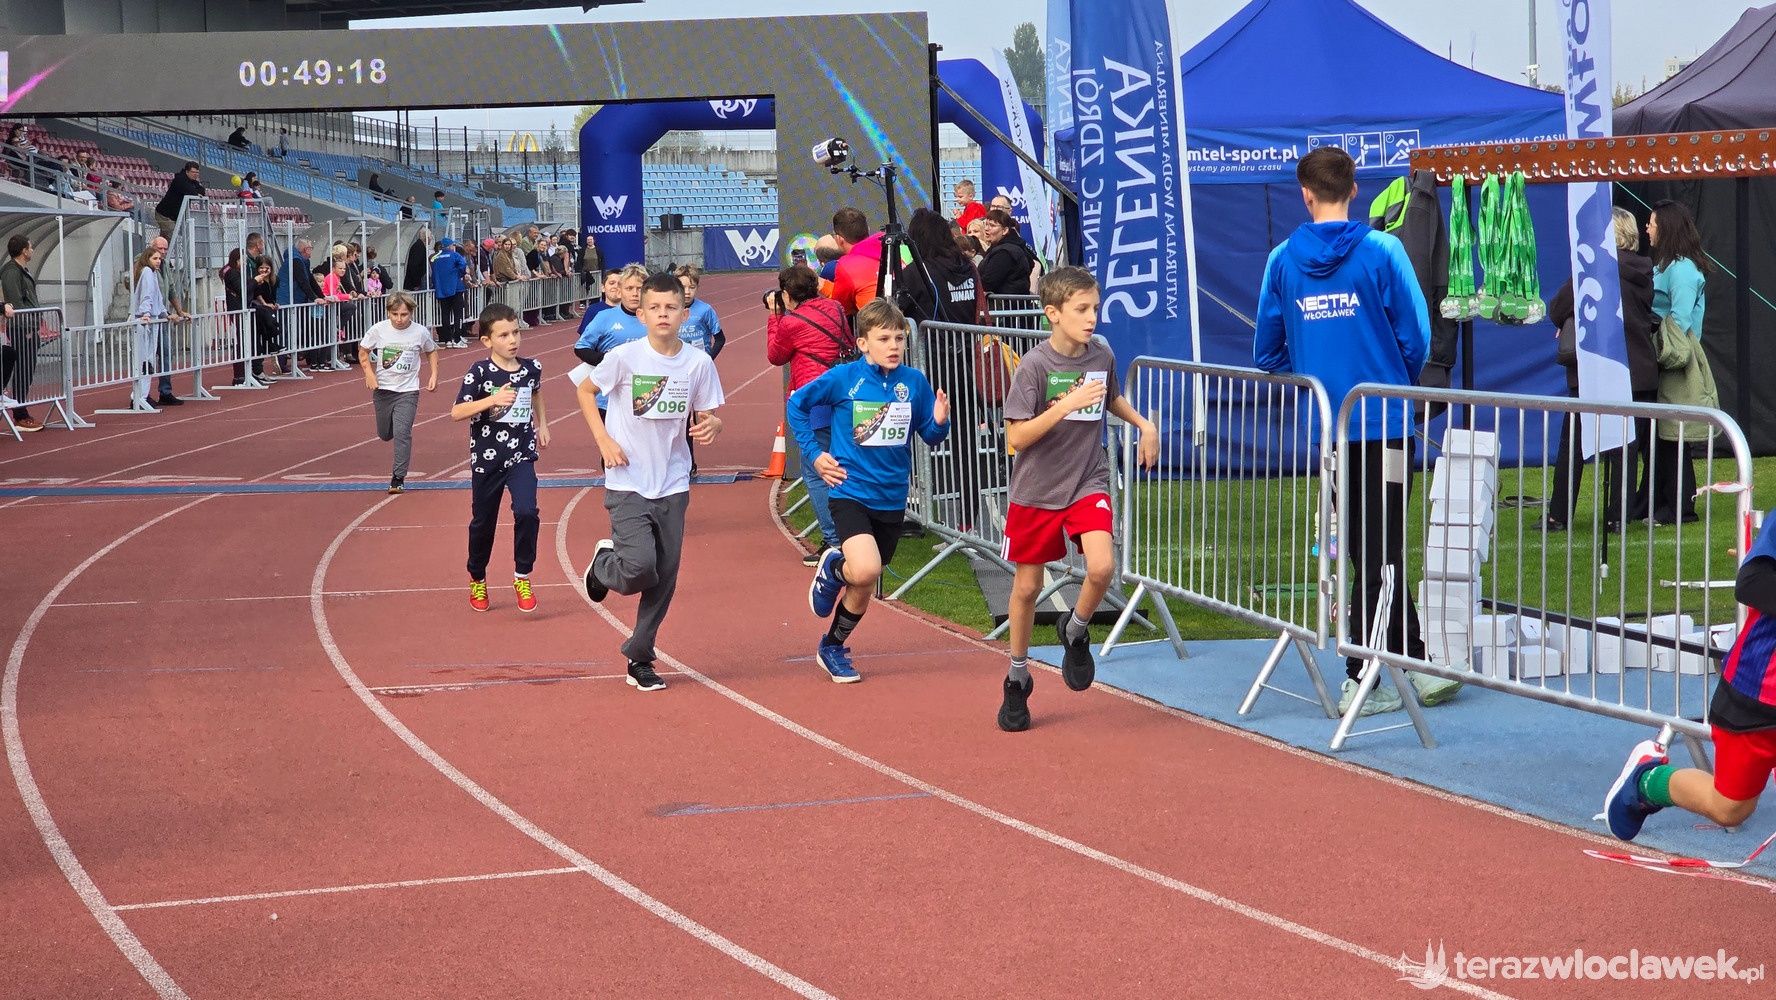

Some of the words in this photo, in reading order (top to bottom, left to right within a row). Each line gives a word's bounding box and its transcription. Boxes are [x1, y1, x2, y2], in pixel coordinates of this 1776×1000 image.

[239, 58, 387, 87] 00:49:18
[1187, 144, 1299, 163] mtel-sport.pl
[1187, 164, 1218, 173] ystemy
[1220, 163, 1256, 172] pomiaru
[1257, 163, 1282, 171] czasu
[587, 224, 638, 234] WŁOCŁAWEK
[1295, 292, 1360, 312] VECTRA
[1303, 308, 1356, 321] WŁOCŁAWEK
[512, 407, 530, 418] 327
[657, 400, 686, 413] 096
[880, 427, 906, 440] 195
